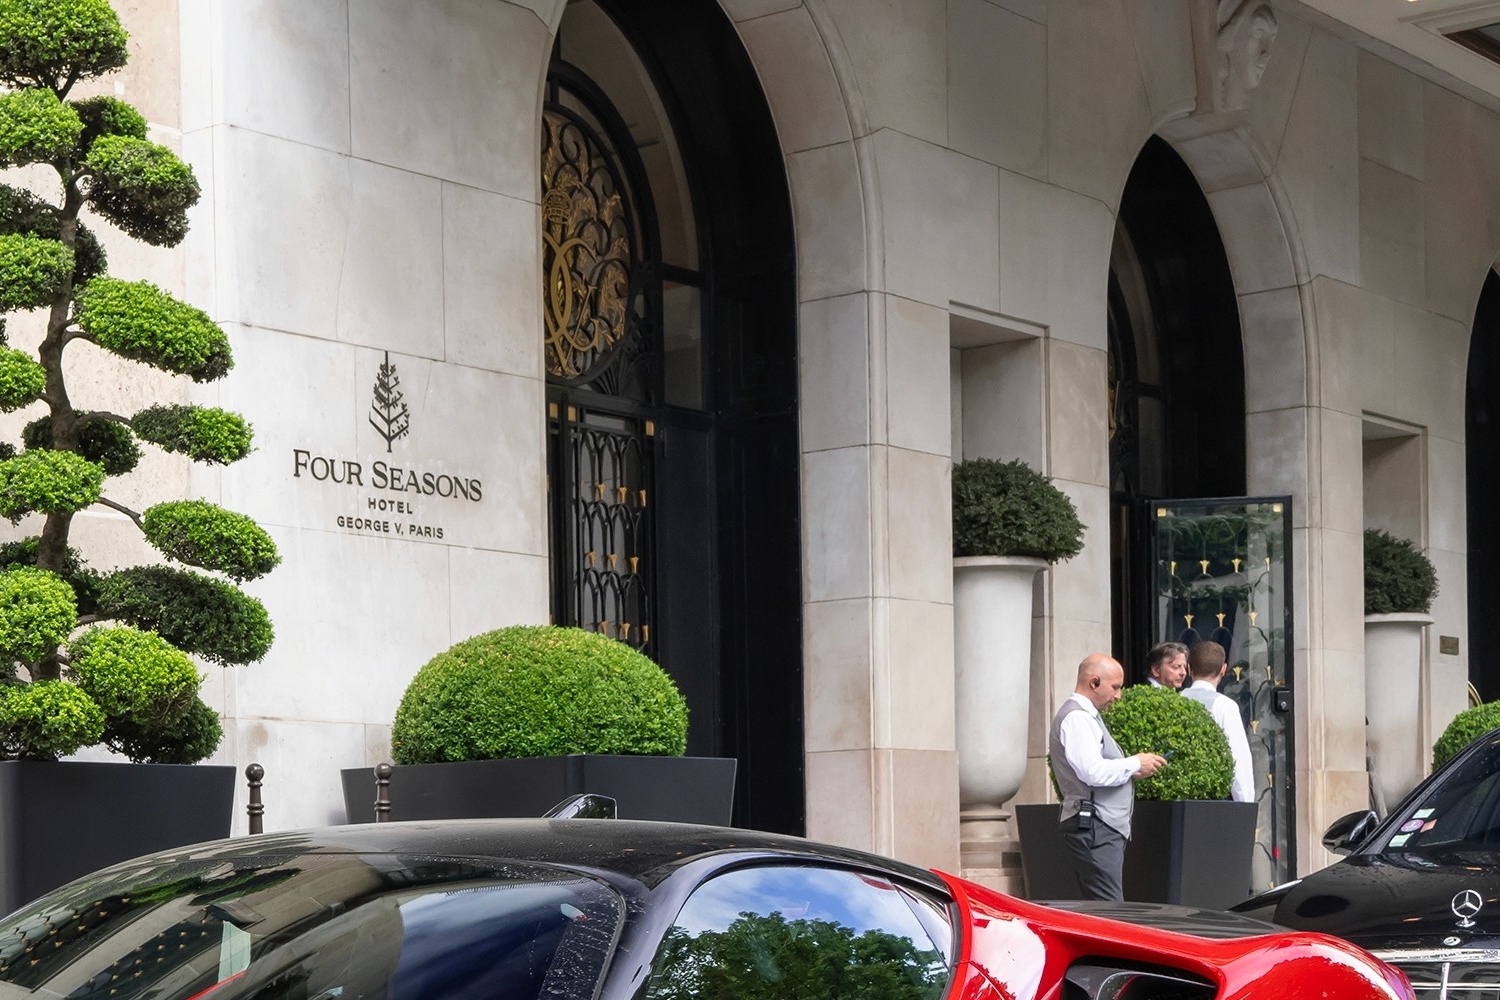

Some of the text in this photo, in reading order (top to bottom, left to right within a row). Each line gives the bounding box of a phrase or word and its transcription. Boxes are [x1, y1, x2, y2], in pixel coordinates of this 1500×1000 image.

[293, 449, 483, 501] FOUR SEASONS
[368, 498, 413, 515] HOTEL
[337, 516, 444, 539] GEORGE V, PARIS
